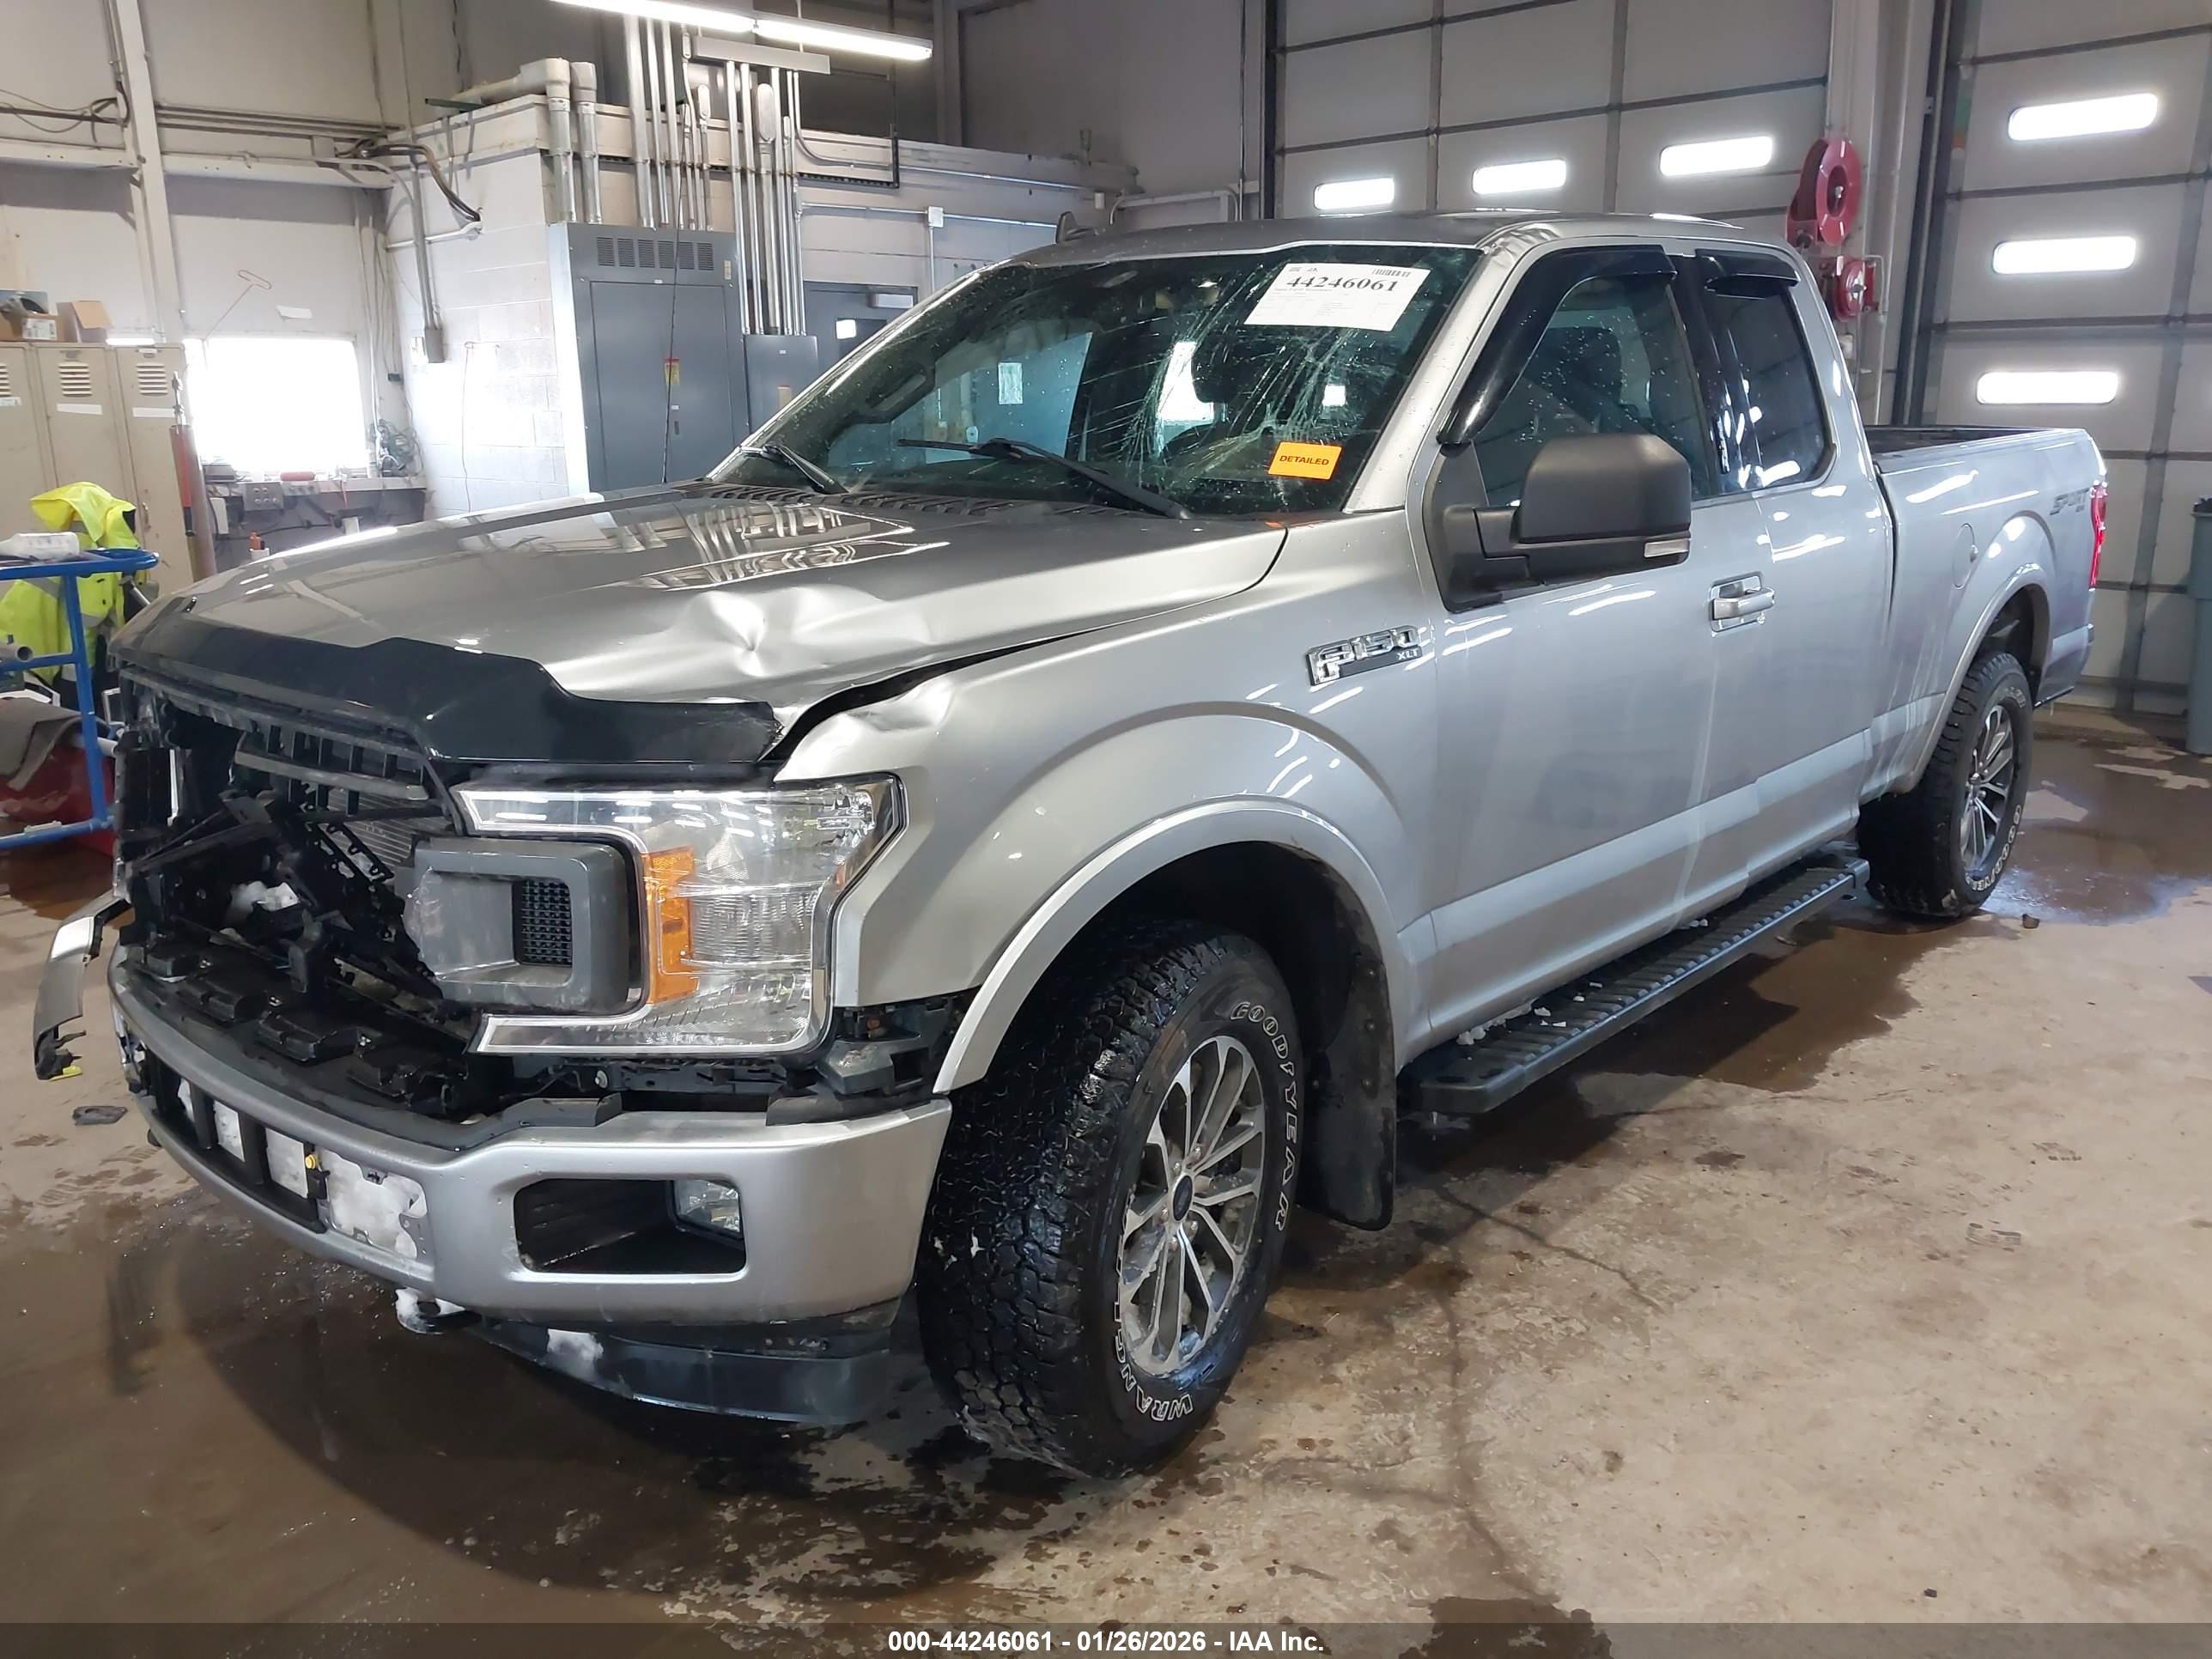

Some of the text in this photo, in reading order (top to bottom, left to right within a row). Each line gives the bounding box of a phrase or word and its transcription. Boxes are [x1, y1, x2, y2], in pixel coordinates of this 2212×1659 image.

[1286, 276, 1399, 292] 44246061
[1279, 455, 1330, 465] DETAILED
[1396, 648, 1419, 661] XLT
[1231, 1000, 1298, 1232] GOODYEAR
